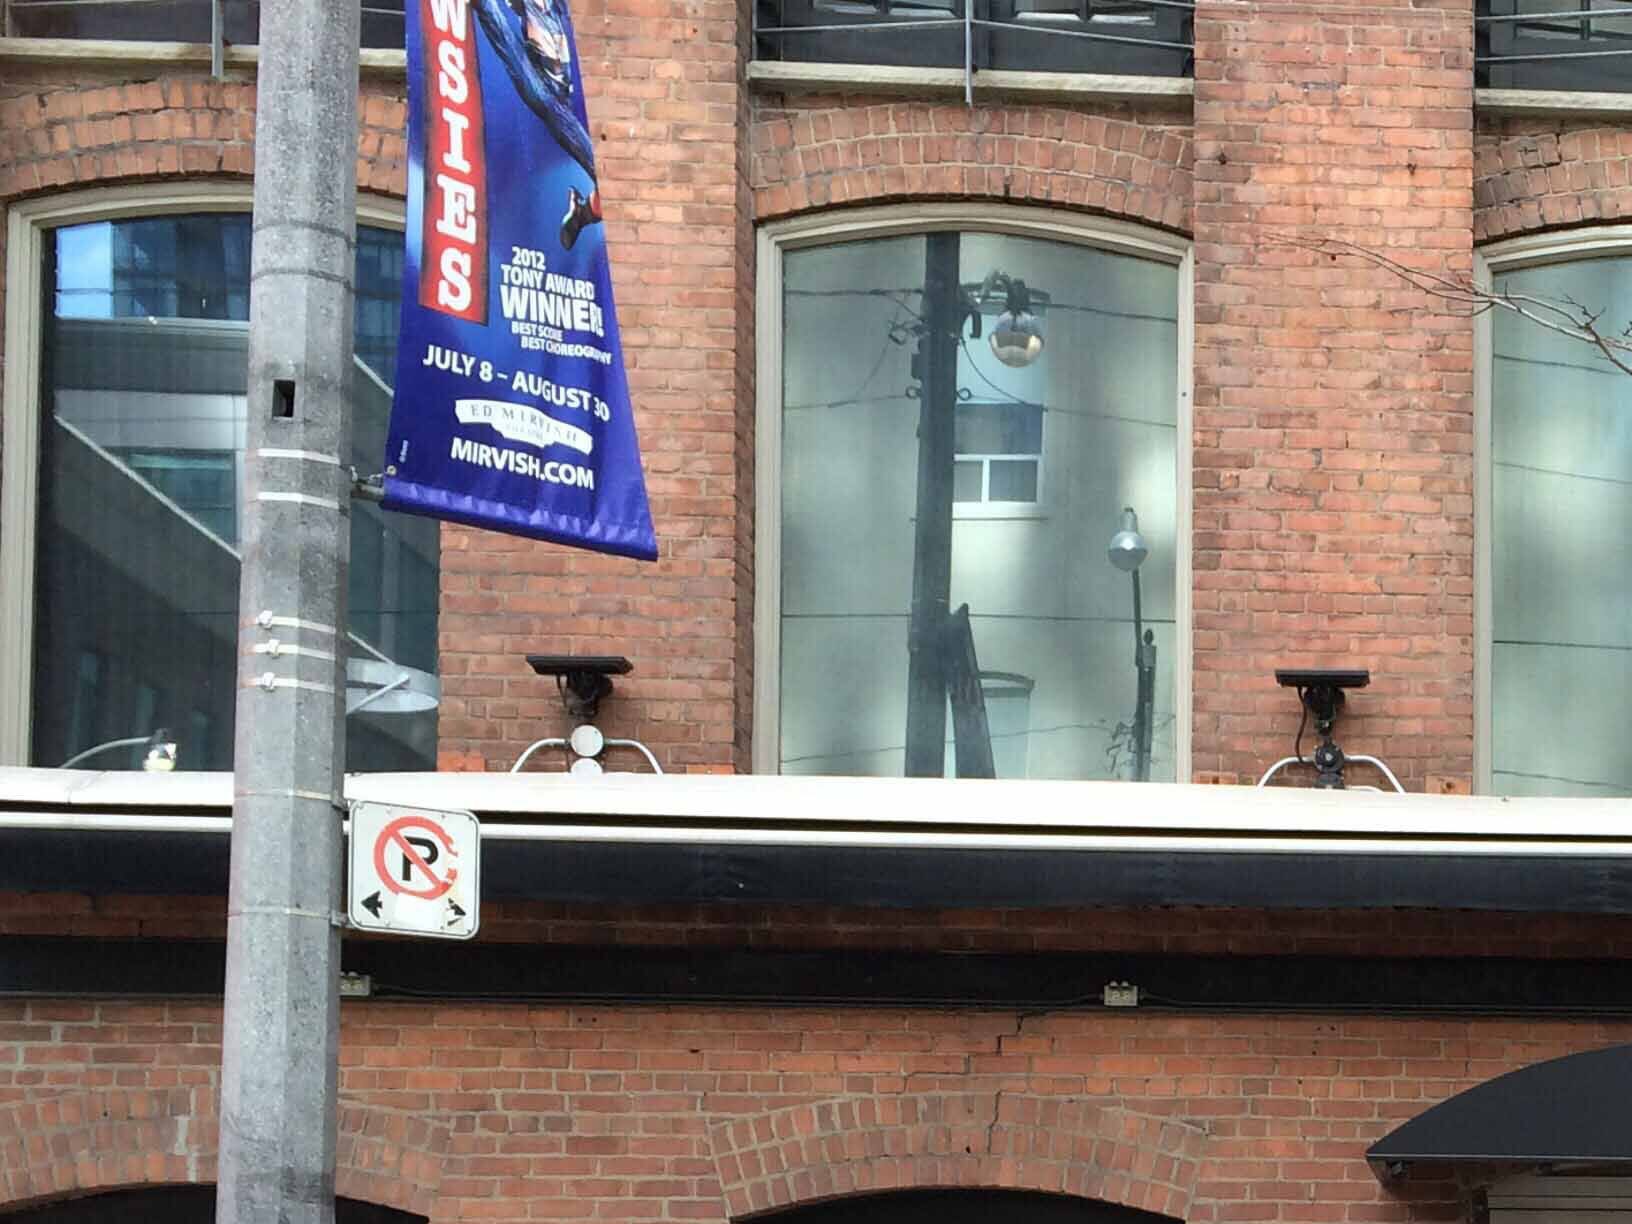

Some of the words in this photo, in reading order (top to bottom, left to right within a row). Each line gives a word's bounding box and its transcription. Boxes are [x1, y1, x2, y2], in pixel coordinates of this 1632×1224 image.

[511, 246, 546, 270] 2012
[500, 263, 544, 289] TONY
[545, 272, 595, 300] AWARD
[499, 284, 605, 337] WINNER!
[511, 320, 537, 335] BEST
[521, 335, 545, 350] BEST
[545, 340, 612, 365] COREOGHY
[422, 344, 476, 377] JULY
[479, 360, 494, 382] 8
[511, 370, 592, 411] AUGUST
[593, 396, 610, 422] 30
[471, 404, 493, 417] ED
[502, 407, 578, 442] MIRVISH
[450, 436, 595, 490] MIRVISH.COM
